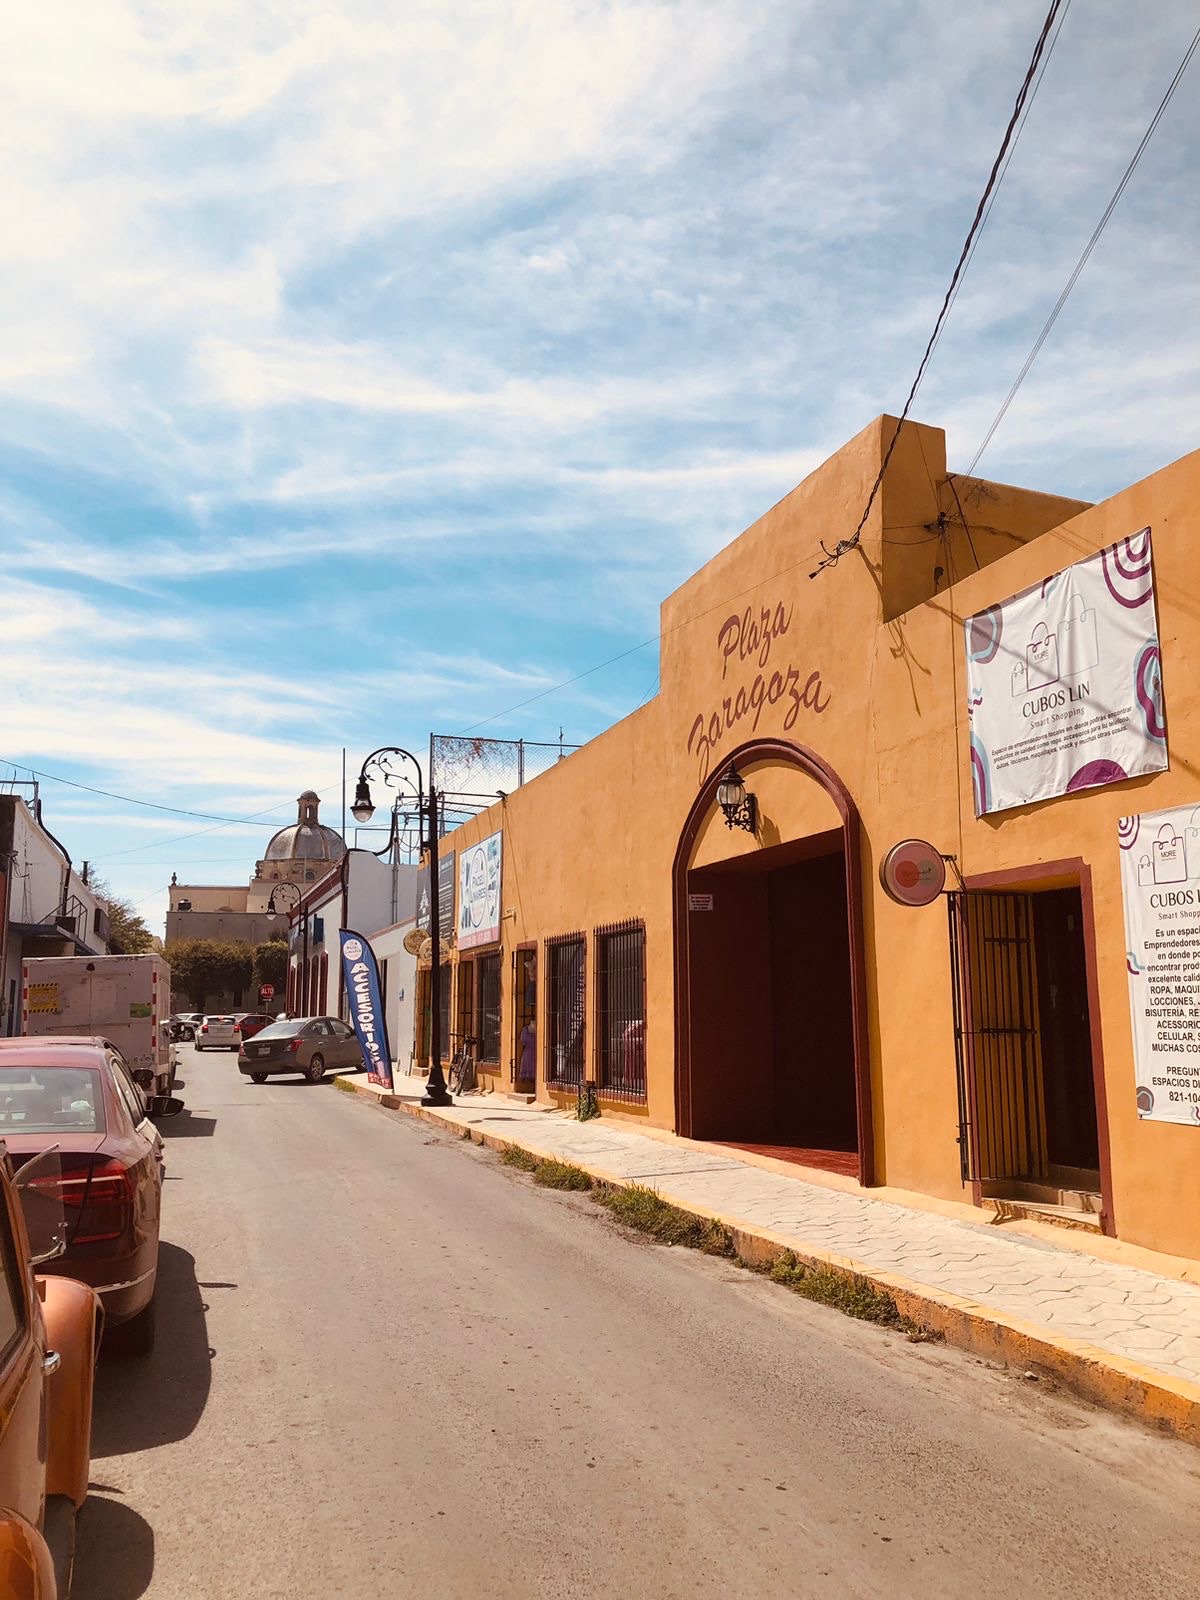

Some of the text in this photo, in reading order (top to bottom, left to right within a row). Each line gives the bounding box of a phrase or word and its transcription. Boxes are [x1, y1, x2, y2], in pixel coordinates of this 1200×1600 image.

[718, 601, 793, 679] Plaza
[1022, 681, 1090, 718] CUBOS LIN
[1107, 705, 1133, 719] encontrar
[1030, 706, 1085, 730] Smart Shopping
[687, 664, 831, 787] Zaragoza
[1160, 850, 1177, 858] MORE
[1150, 889, 1194, 909] CUBOS
[1158, 912, 1178, 920] Smart
[1155, 929, 1164, 938] Es
[1166, 929, 1176, 937] un
[1168, 951, 1191, 960] donde
[1147, 963, 1181, 972] encontrar
[1148, 974, 1182, 983] excelente
[261, 987, 273, 995] ALTO
[1150, 985, 1173, 995] ROPA,
[1150, 996, 1196, 1006] LOCCIONES,
[350, 962, 381, 1063] ACCESORIOS
[1157, 1031, 1196, 1042] CELULAR,
[1152, 1043, 1185, 1053] MUCHAS
[1152, 1077, 1191, 1088] ESPACIOS
